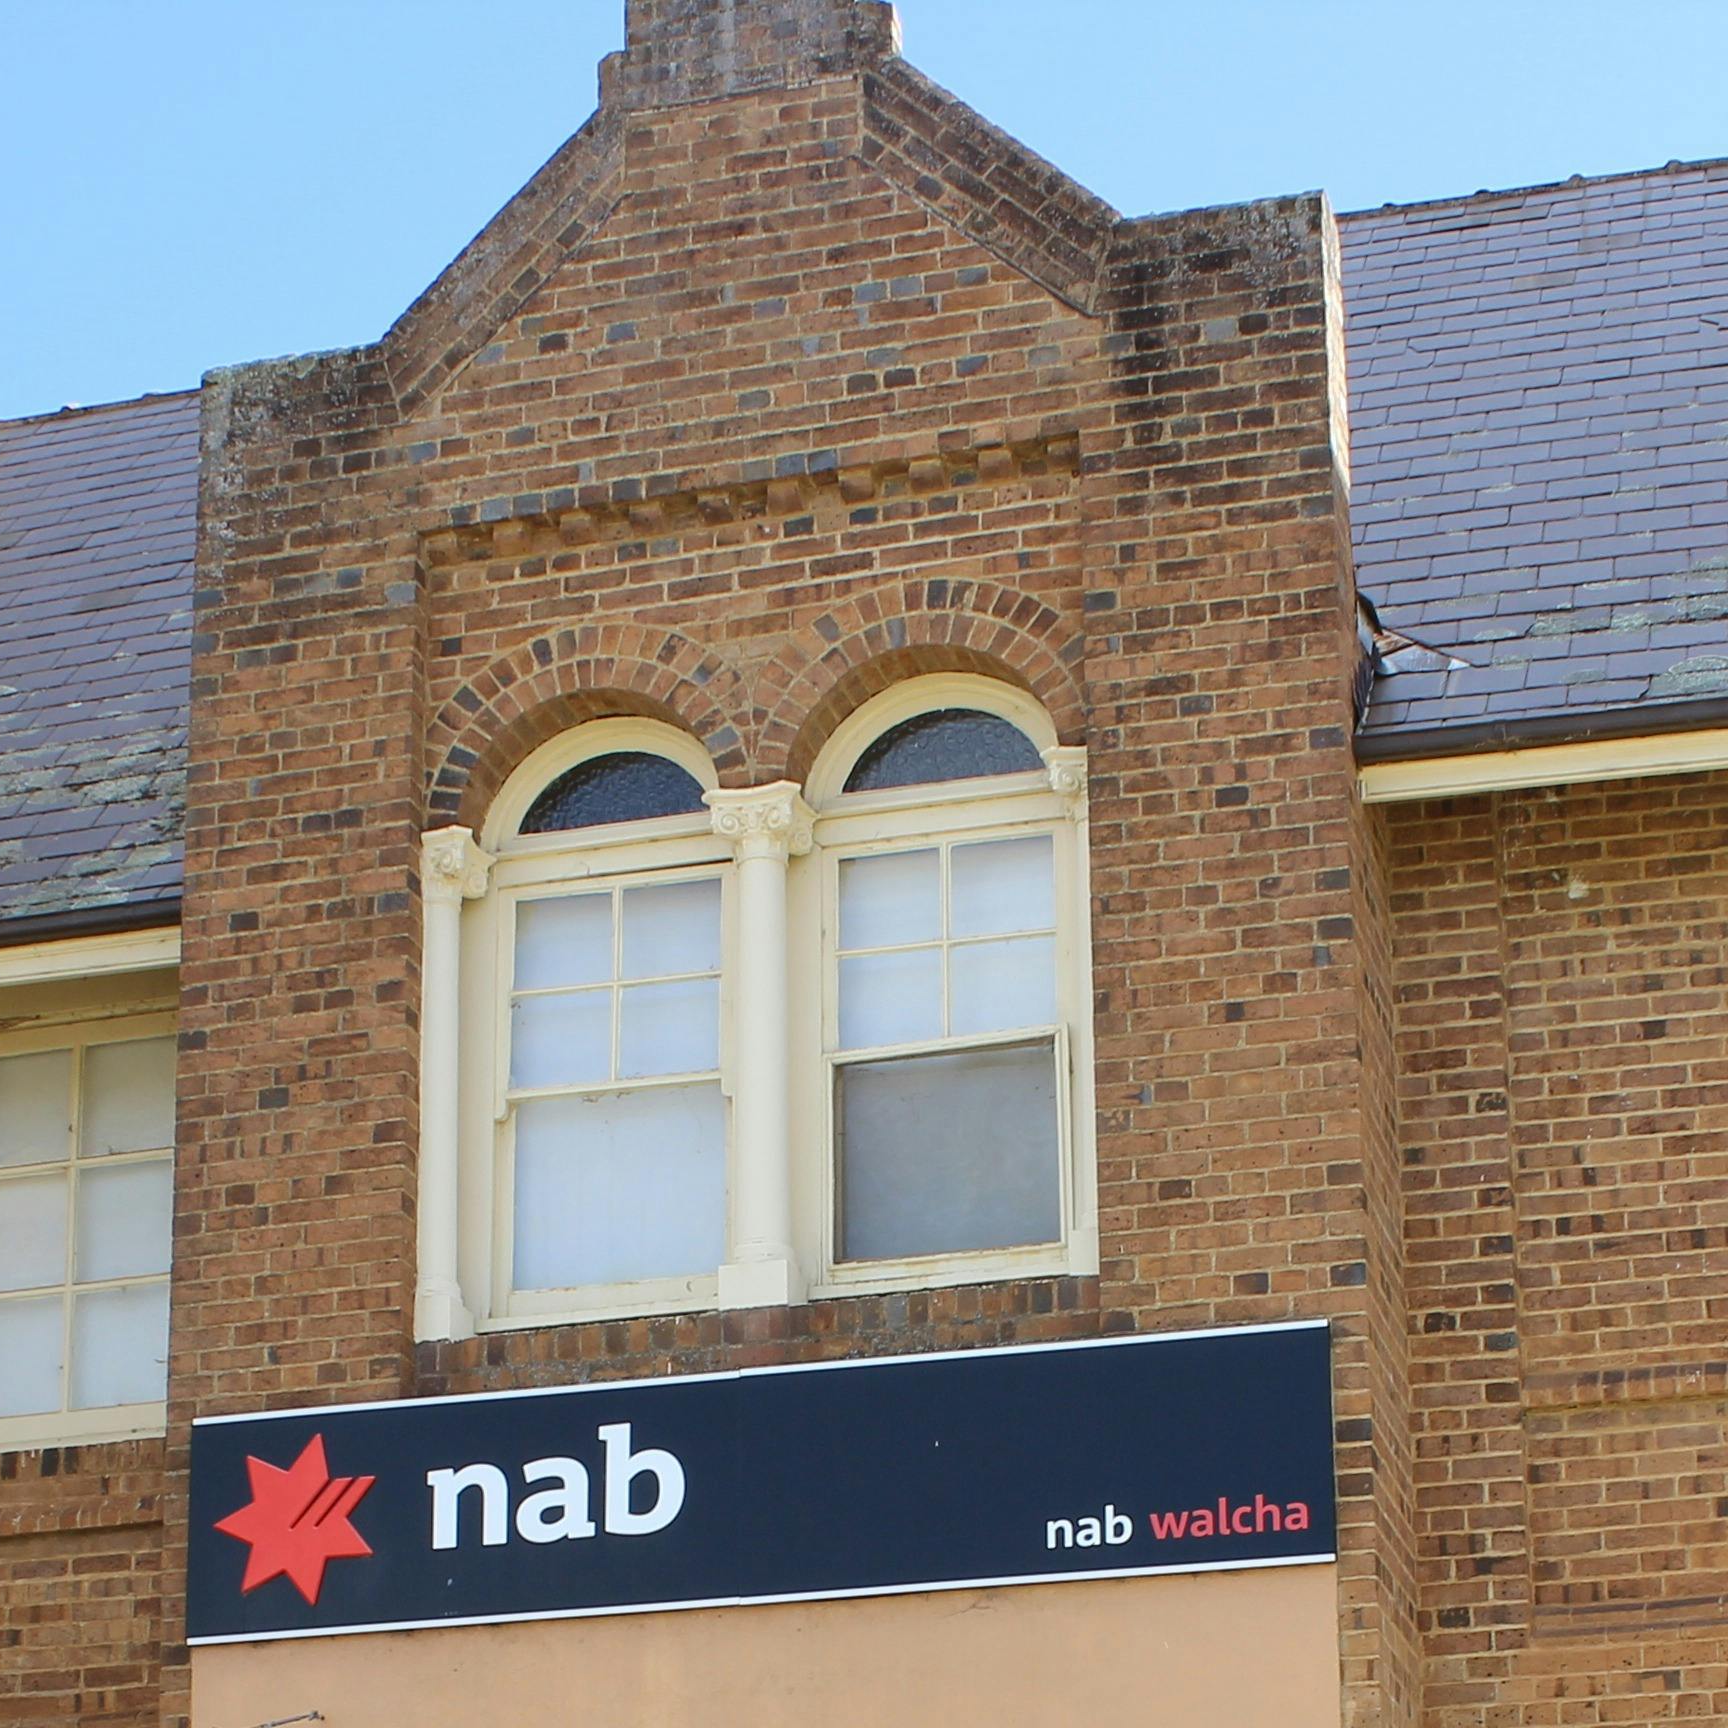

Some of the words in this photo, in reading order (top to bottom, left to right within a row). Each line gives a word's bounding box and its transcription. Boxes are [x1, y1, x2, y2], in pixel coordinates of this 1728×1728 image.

[426, 1421, 687, 1550] nab
[1045, 1503, 1134, 1550] nab
[1149, 1493, 1310, 1541] walcha
